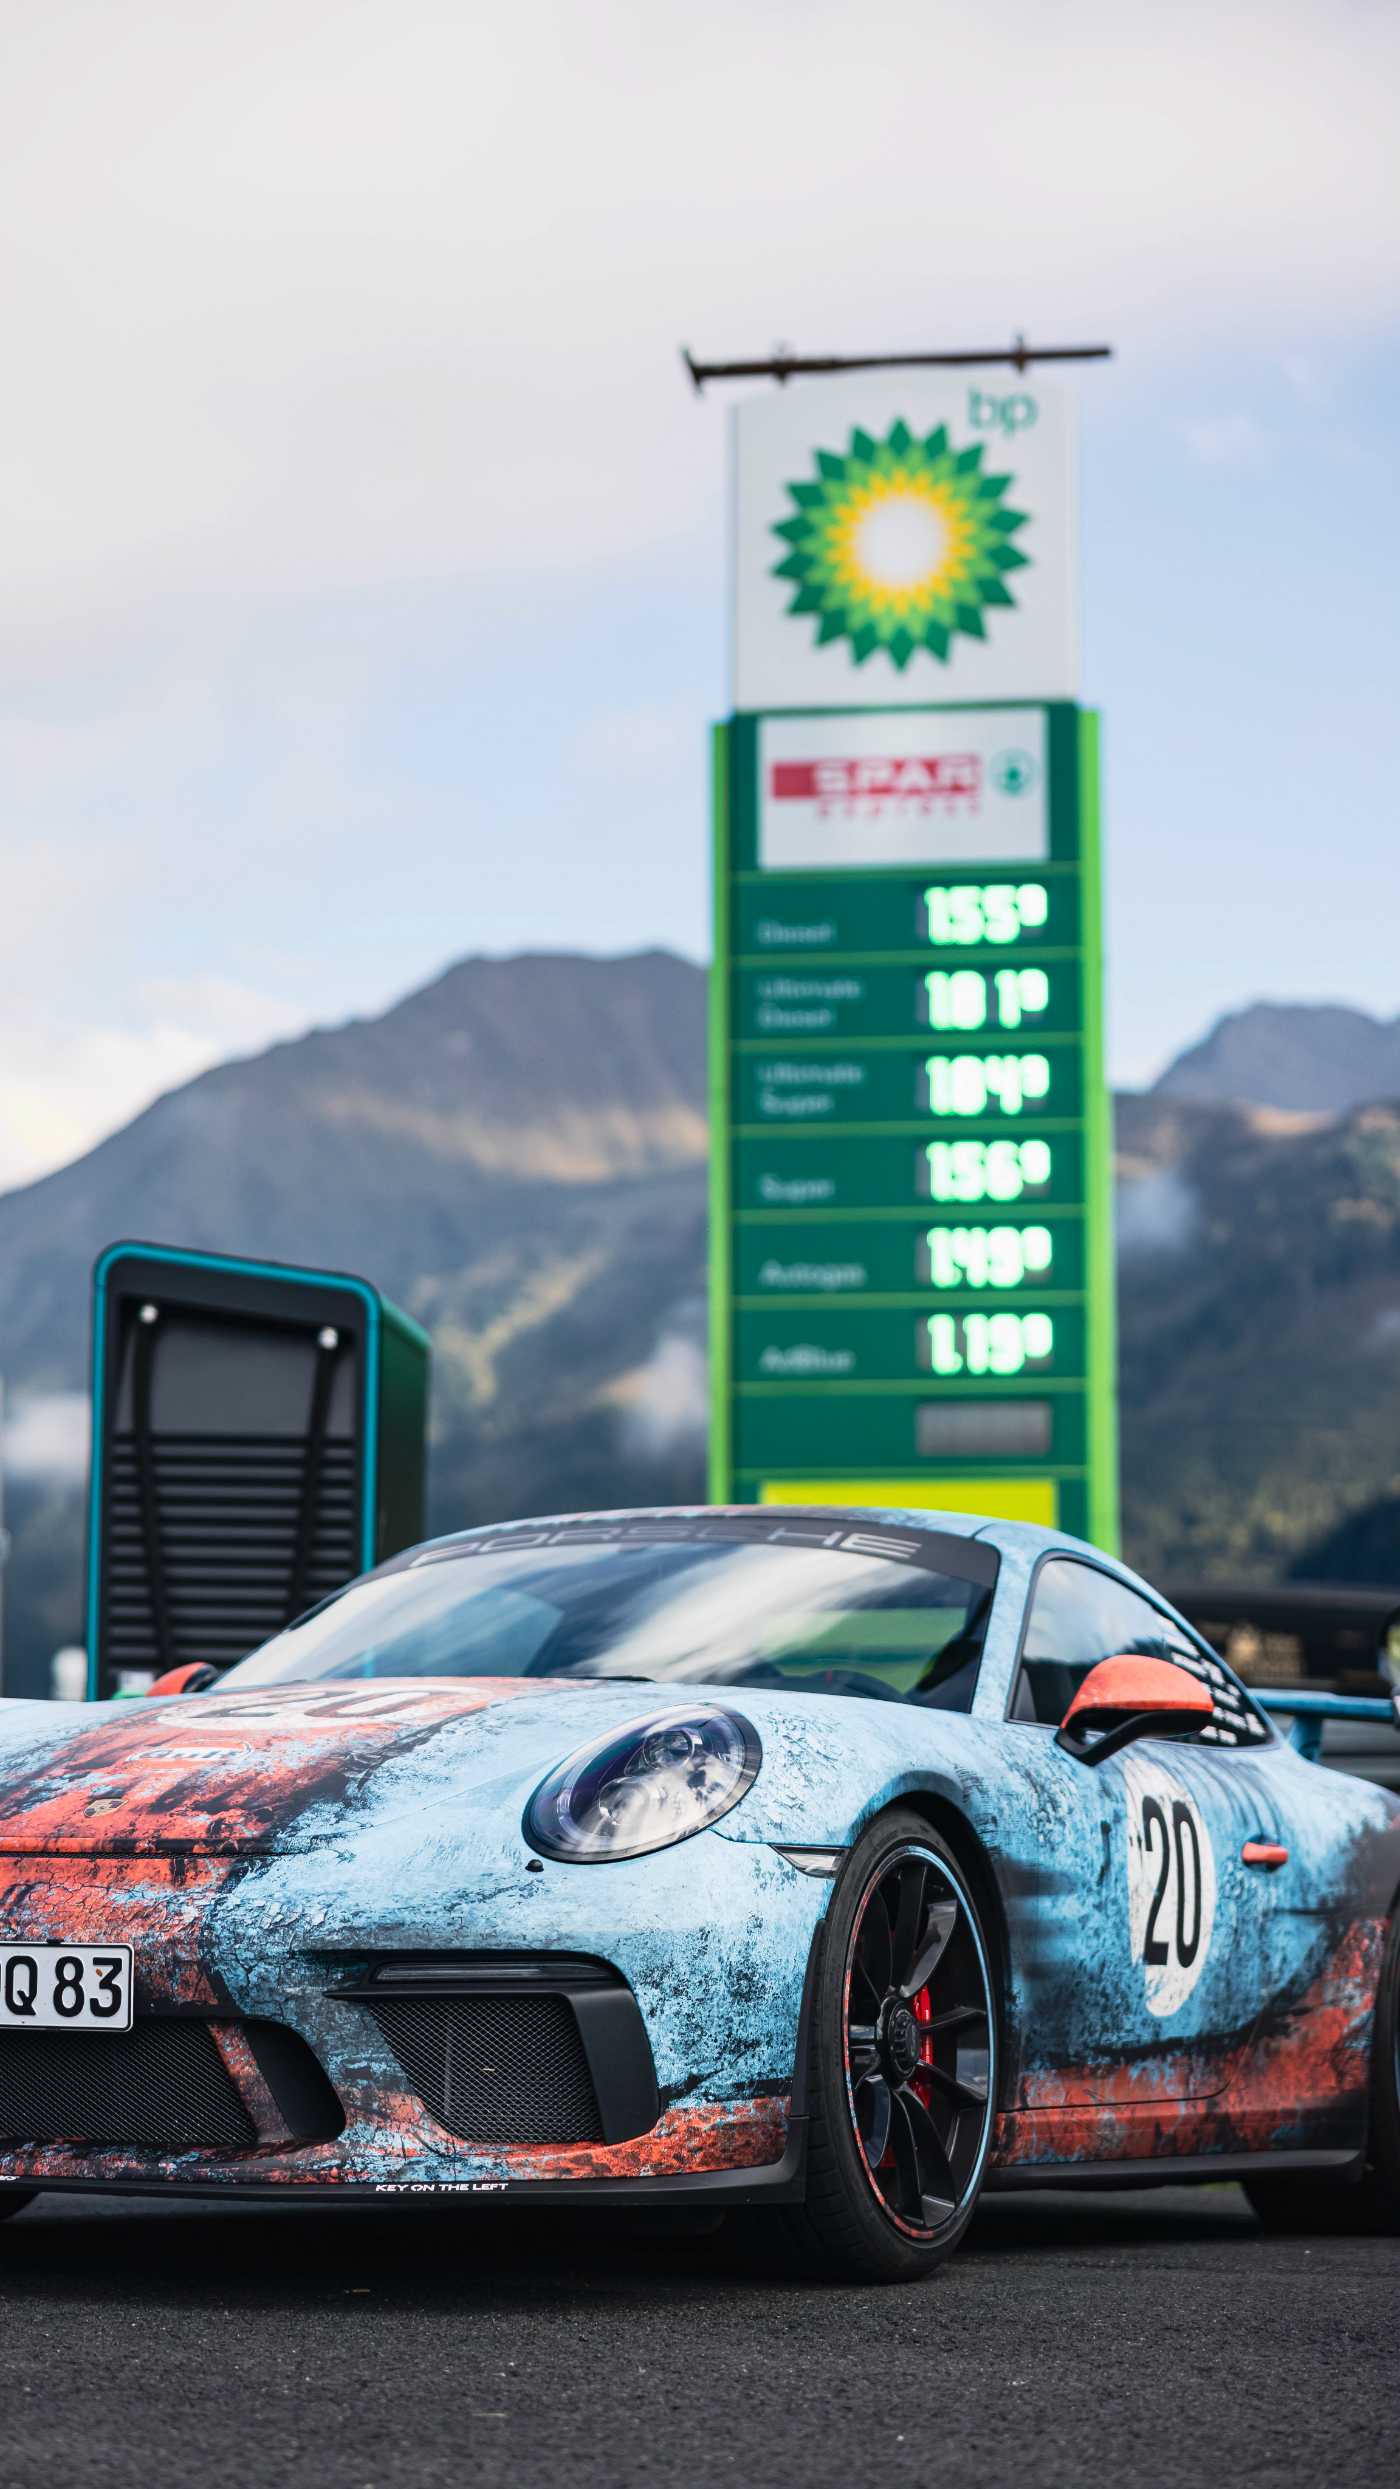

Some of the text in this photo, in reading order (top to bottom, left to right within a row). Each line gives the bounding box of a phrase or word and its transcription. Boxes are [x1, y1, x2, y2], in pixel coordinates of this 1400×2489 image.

[967, 385, 1039, 438] bp
[814, 757, 979, 793] SPAR
[409, 1525, 922, 1567] PORSCHE
[188, 1691, 455, 1717] 20
[1142, 1796, 1201, 1968] 20
[0, 1955, 123, 2017] Q 83
[375, 2184, 408, 2192] KEY
[411, 2184, 435, 2192] ON
[472, 2183, 508, 2191] LEFT
